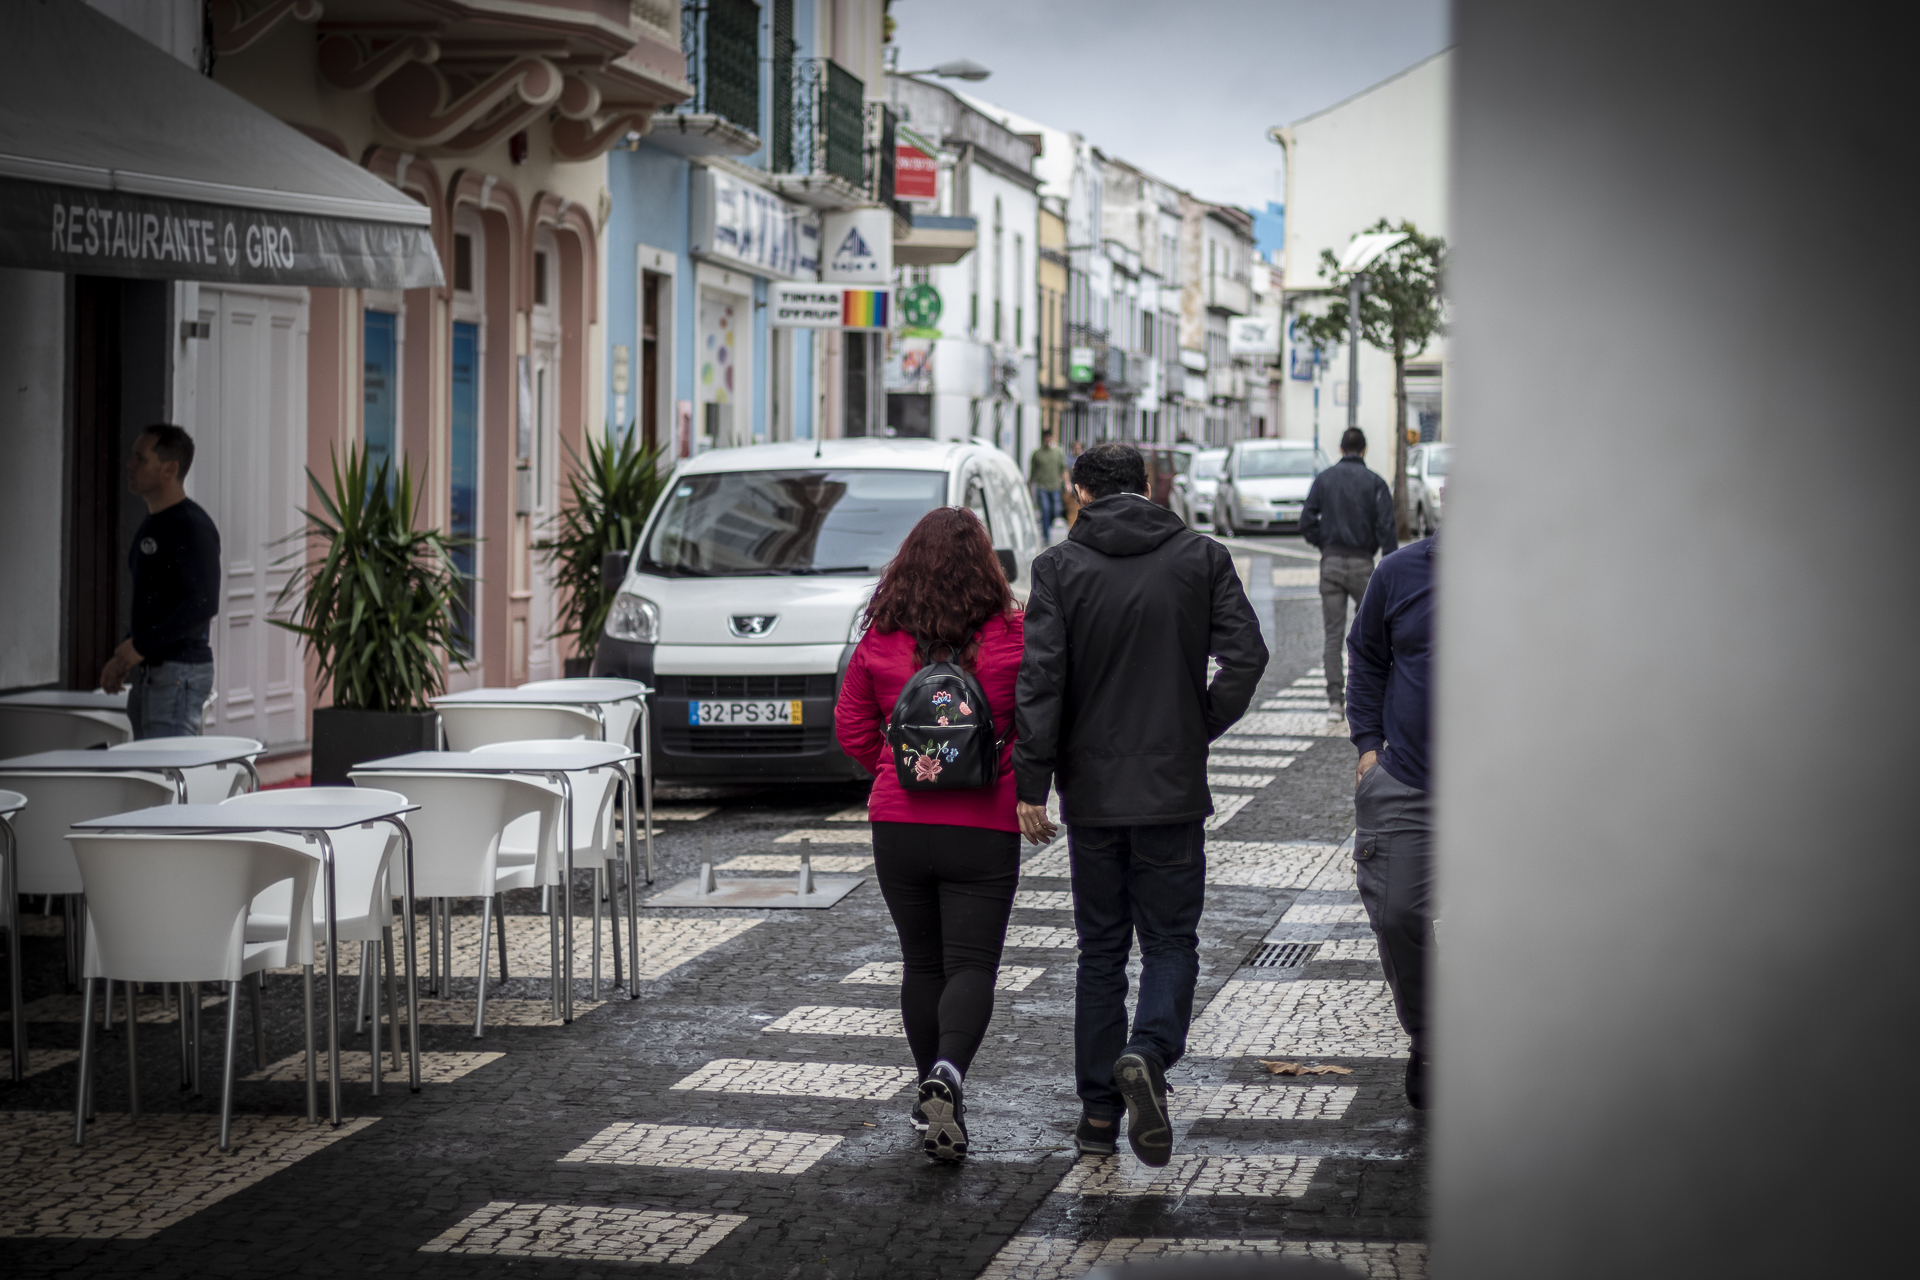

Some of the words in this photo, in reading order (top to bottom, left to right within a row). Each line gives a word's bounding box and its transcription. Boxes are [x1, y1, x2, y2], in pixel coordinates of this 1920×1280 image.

[52, 203, 217, 265] RESTAURANTE
[224, 221, 237, 267] O
[245, 223, 295, 270] GIRO
[781, 292, 839, 304] TINTAS
[778, 308, 839, 320] DYRUP
